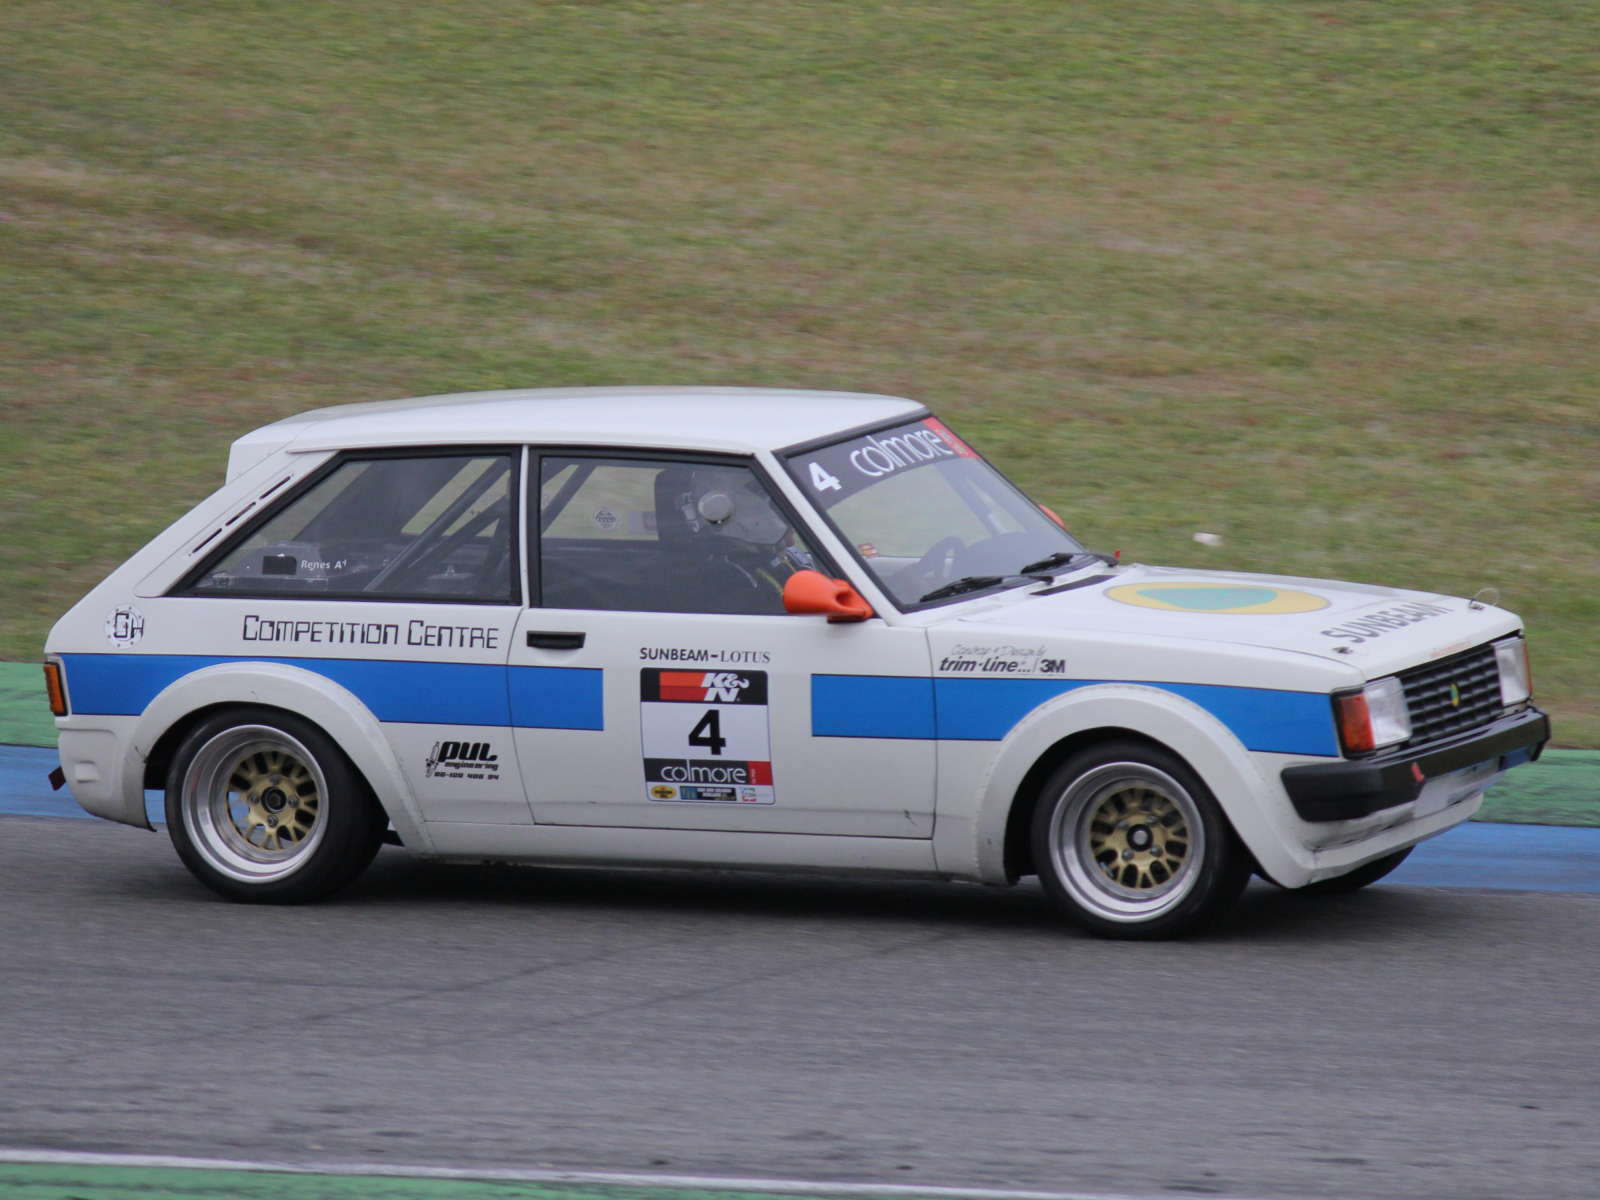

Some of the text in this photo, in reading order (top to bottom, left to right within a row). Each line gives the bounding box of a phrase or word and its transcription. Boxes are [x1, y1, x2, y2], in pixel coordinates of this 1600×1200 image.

[808, 461, 842, 491] 4
[850, 429, 954, 477] colmore
[1321, 602, 1455, 643] SUNBEAM
[1040, 659, 1066, 673] 3M
[688, 709, 727, 756] 4
[445, 761, 499, 771] engineering
[661, 759, 747, 784] colmore
